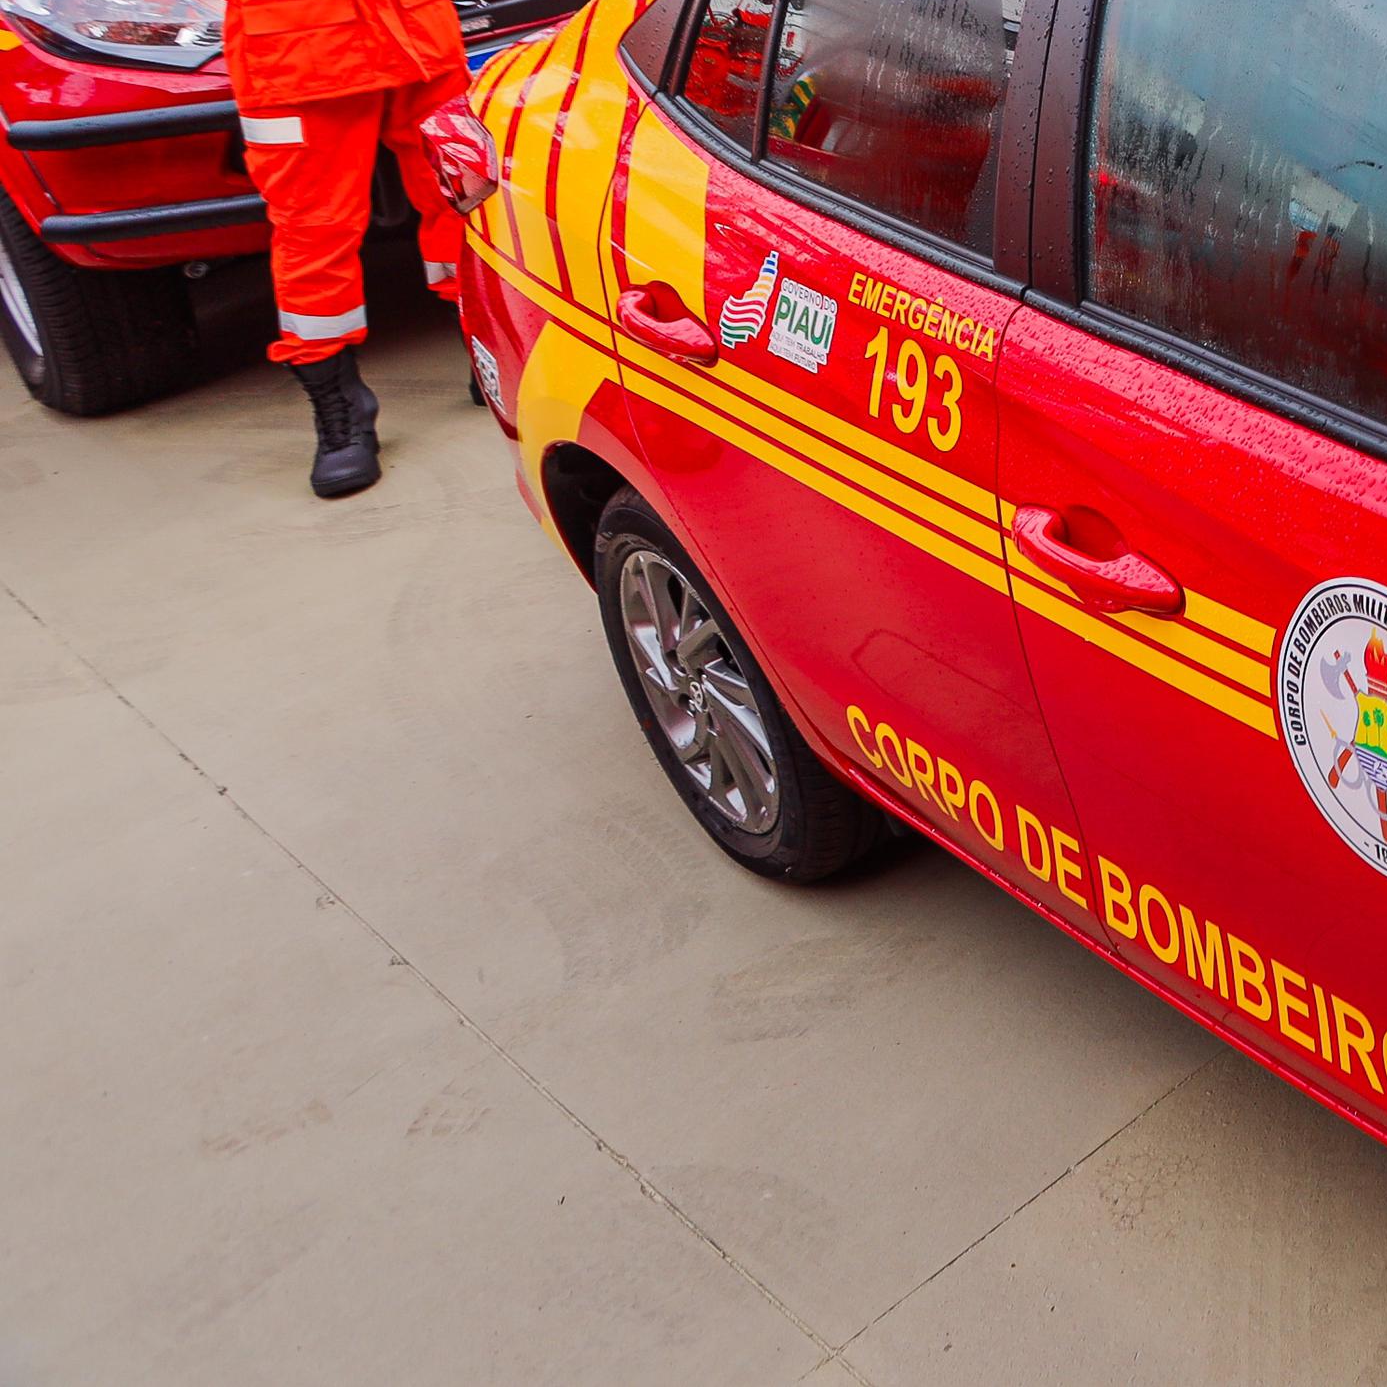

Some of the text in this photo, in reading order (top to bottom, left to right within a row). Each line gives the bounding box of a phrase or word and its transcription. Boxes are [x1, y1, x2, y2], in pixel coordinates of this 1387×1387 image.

[774, 294, 833, 350] PIAUÍ
[782, 280, 836, 313] GOVERNO DO
[848, 272, 996, 362] EMERGÊNCIA
[865, 326, 963, 452] 193
[1292, 592, 1352, 659] BOMBEIROS
[1288, 650, 1303, 680] DE
[1287, 678, 1308, 747] CORPO
[845, 705, 1004, 852] CORPO
[1016, 804, 1088, 910] DE
